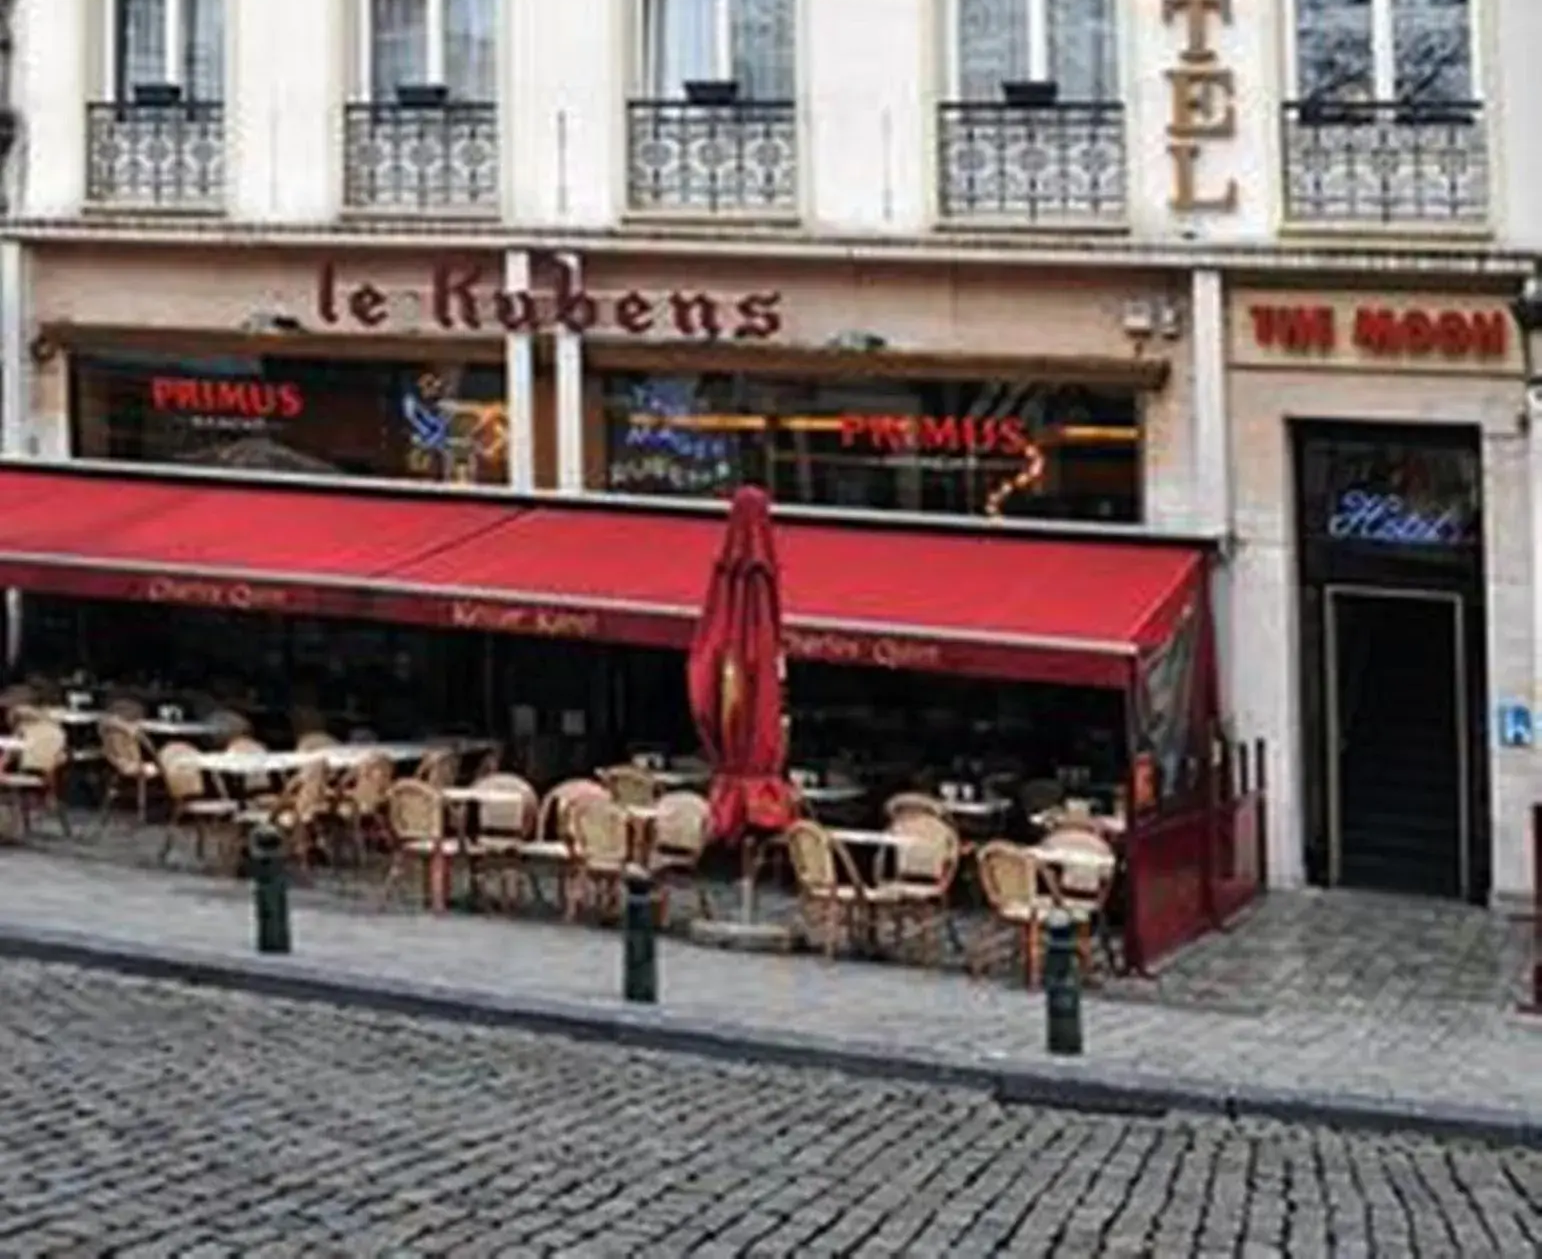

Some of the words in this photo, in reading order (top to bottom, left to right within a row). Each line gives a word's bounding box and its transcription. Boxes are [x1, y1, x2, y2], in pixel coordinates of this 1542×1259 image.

[317, 259, 389, 326] le
[430, 248, 783, 342] Rubens
[1250, 303, 1336, 357] THE
[1352, 303, 1509, 361] MOON
[152, 375, 305, 418] PRIMUS
[839, 413, 1028, 455] PRIMUS
